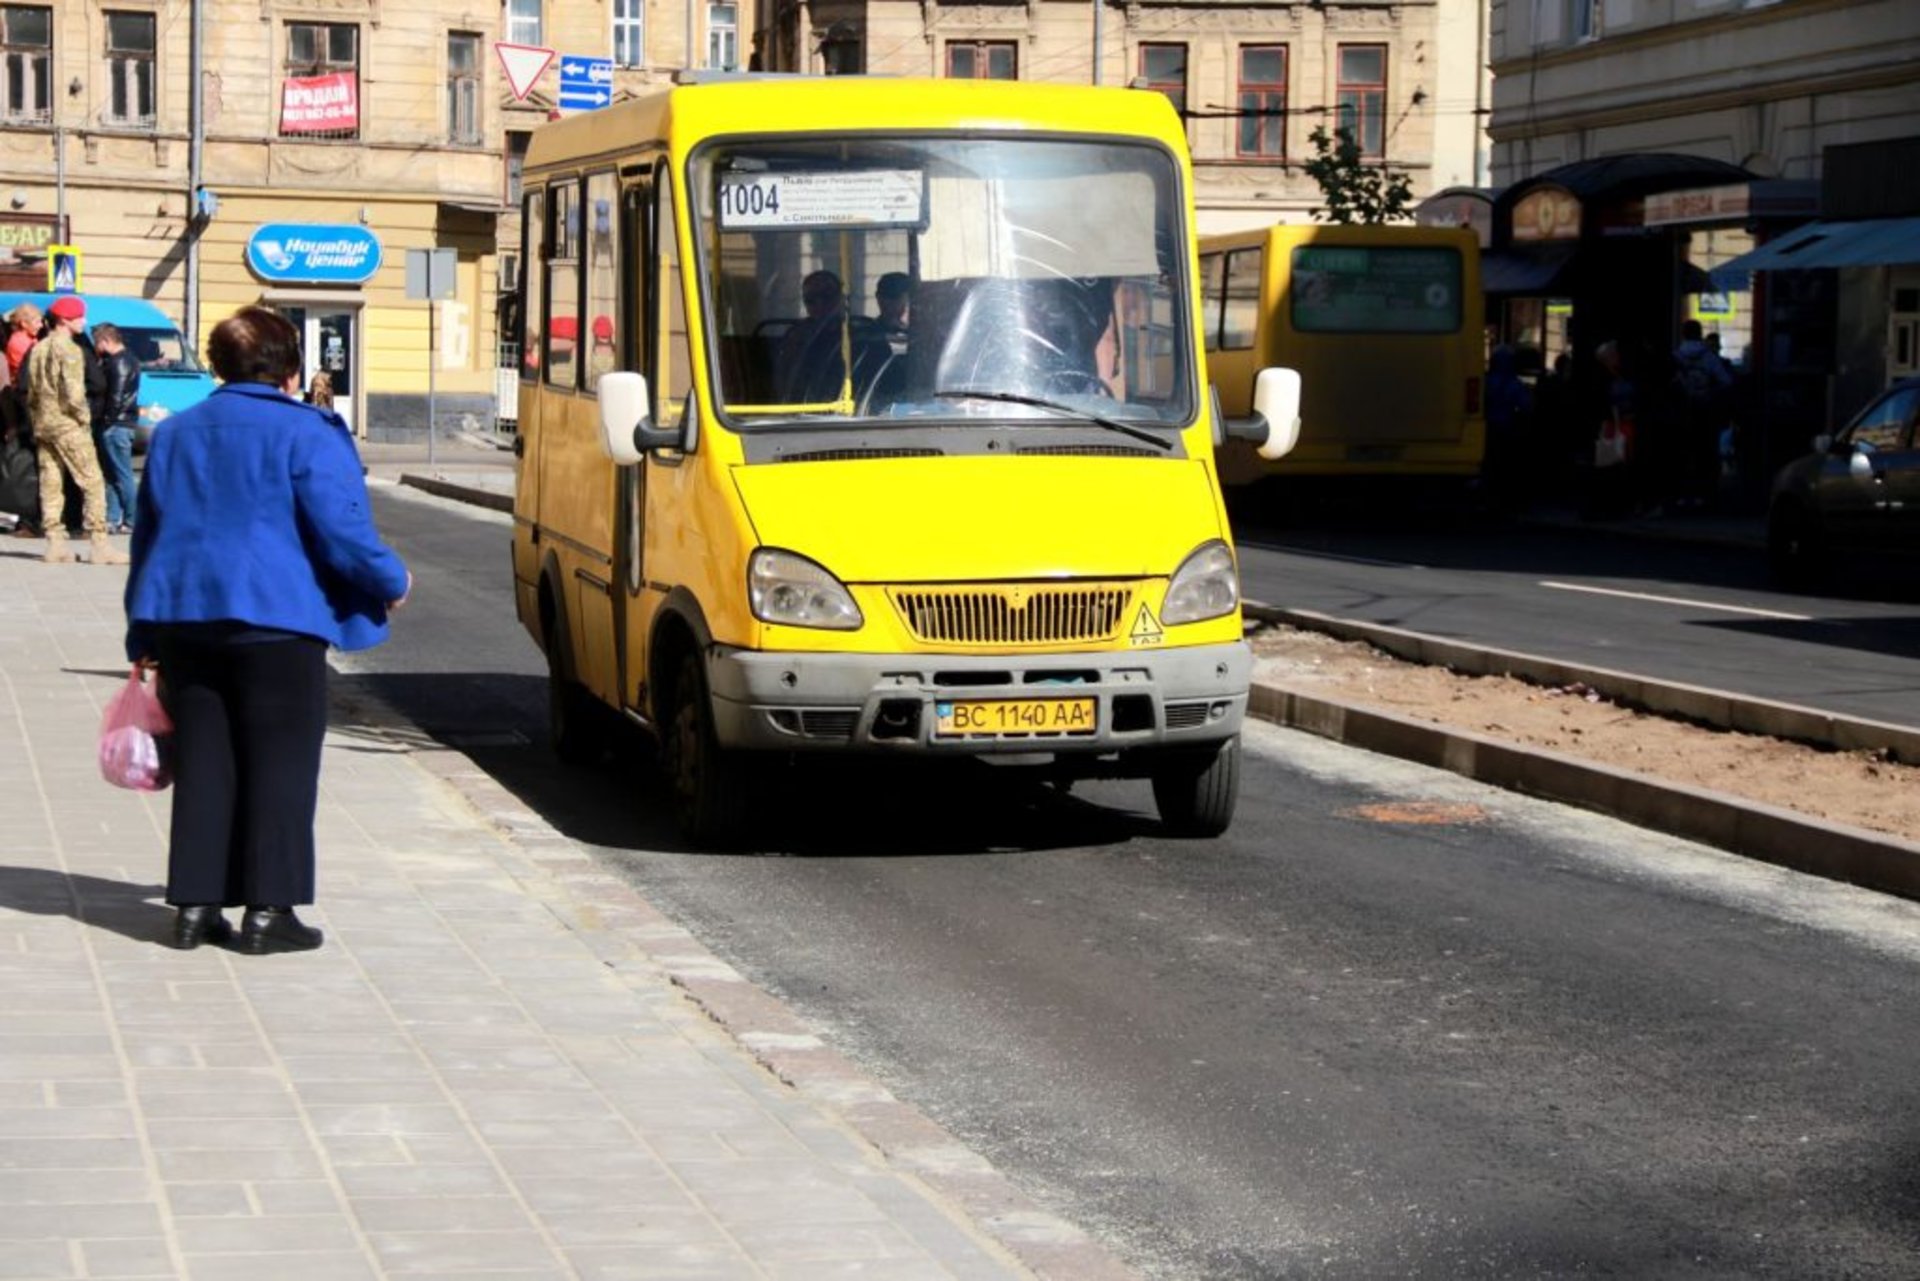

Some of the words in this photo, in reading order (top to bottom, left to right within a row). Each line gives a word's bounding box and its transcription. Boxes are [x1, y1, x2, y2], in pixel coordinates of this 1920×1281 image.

[720, 184, 779, 215] 1004
[953, 704, 987, 728] BC
[996, 703, 1047, 727] 1140
[1053, 702, 1085, 726] AA
